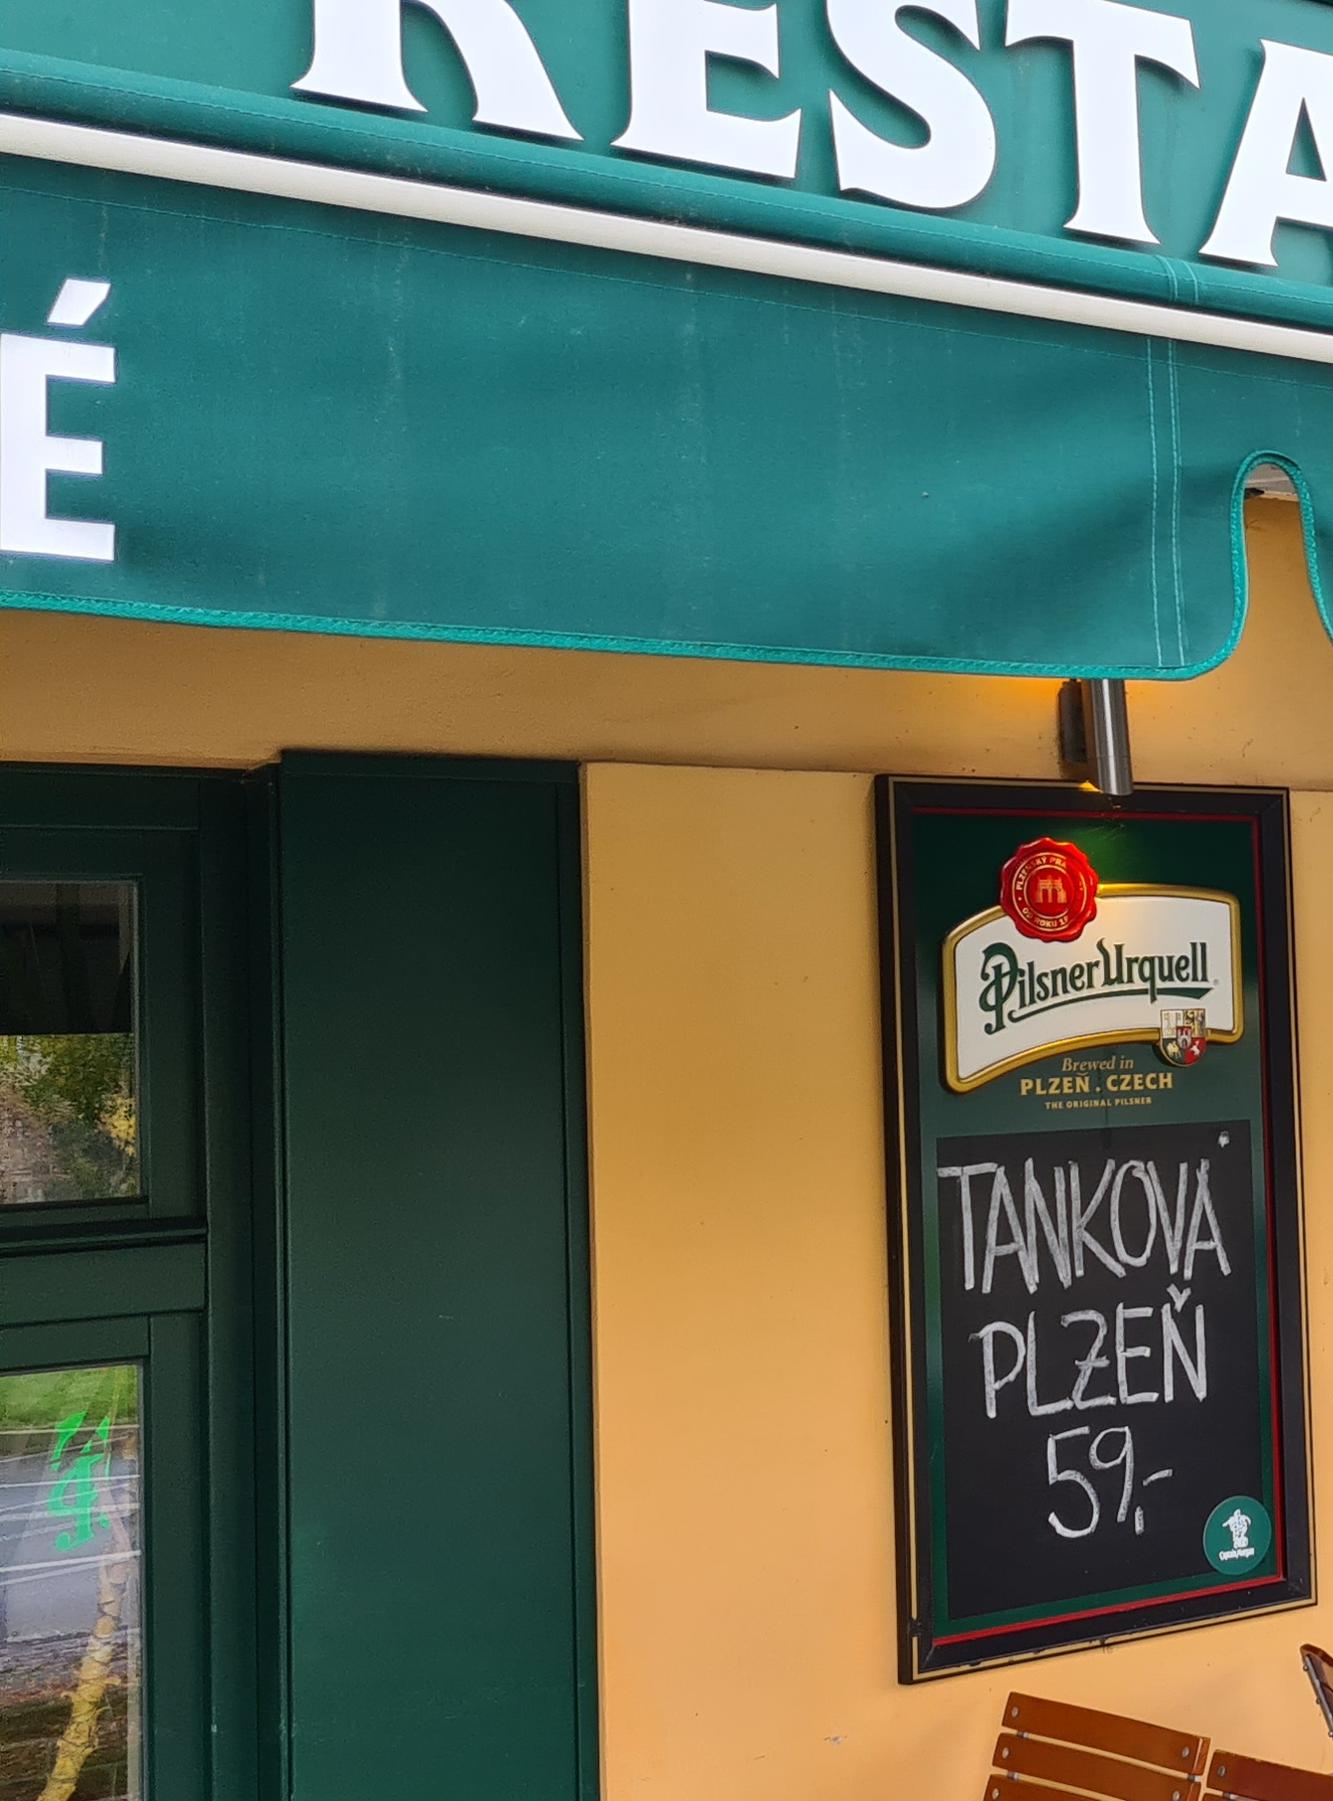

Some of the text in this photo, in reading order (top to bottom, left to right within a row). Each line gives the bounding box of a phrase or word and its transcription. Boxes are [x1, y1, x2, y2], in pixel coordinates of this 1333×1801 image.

[978, 938, 1208, 1036] Pilsner Urquell
[1020, 1071, 1173, 1096] PLZEŇ CZECH
[1062, 1054, 1134, 1072] Brewed in
[1045, 1096, 1152, 1110] THE ORIGINAL PILSNER
[937, 1131, 1232, 1294] TANKOVÁ
[969, 1284, 1208, 1419] PLZEŇ
